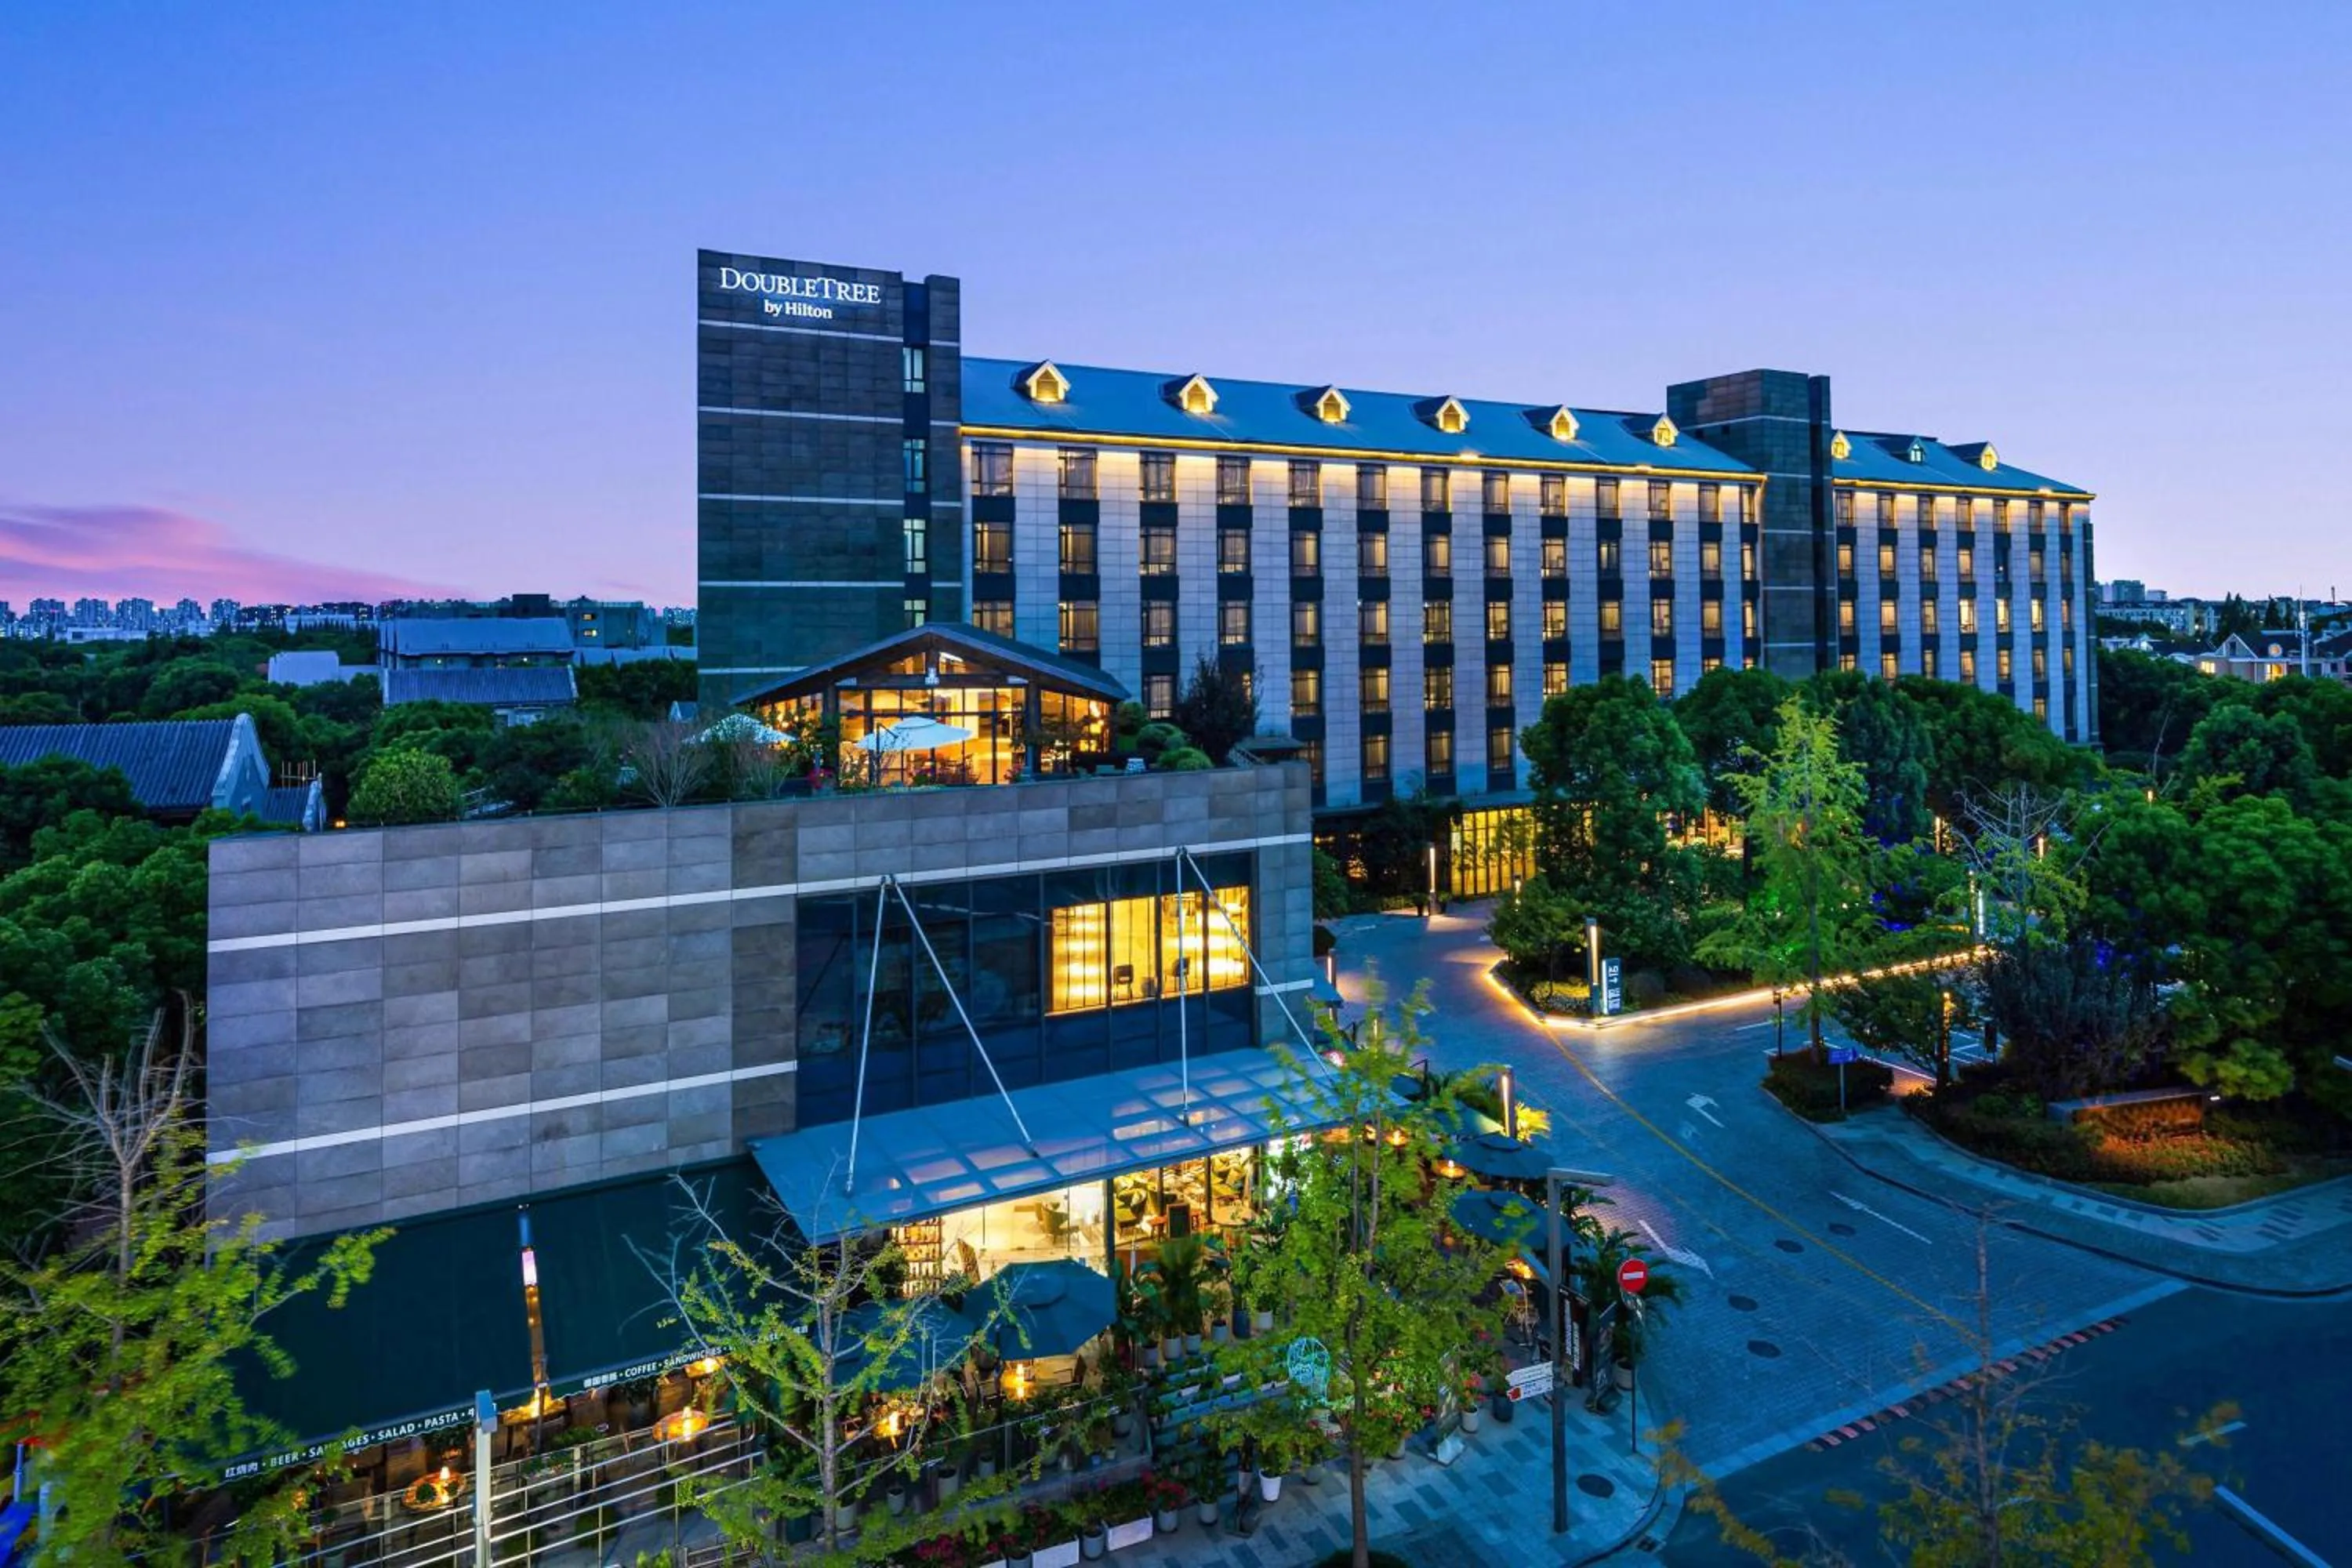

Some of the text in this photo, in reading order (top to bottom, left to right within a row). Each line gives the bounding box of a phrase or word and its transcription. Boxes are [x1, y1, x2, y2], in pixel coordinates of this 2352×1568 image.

[764, 299, 833, 319] by Hilton
[625, 1362, 657, 1377] COFFEE
[270, 1451, 299, 1468] BEER
[308, 1434, 369, 1458] SAAGES
[377, 1423, 416, 1441] SALAD
[424, 1411, 459, 1428] PASTA
